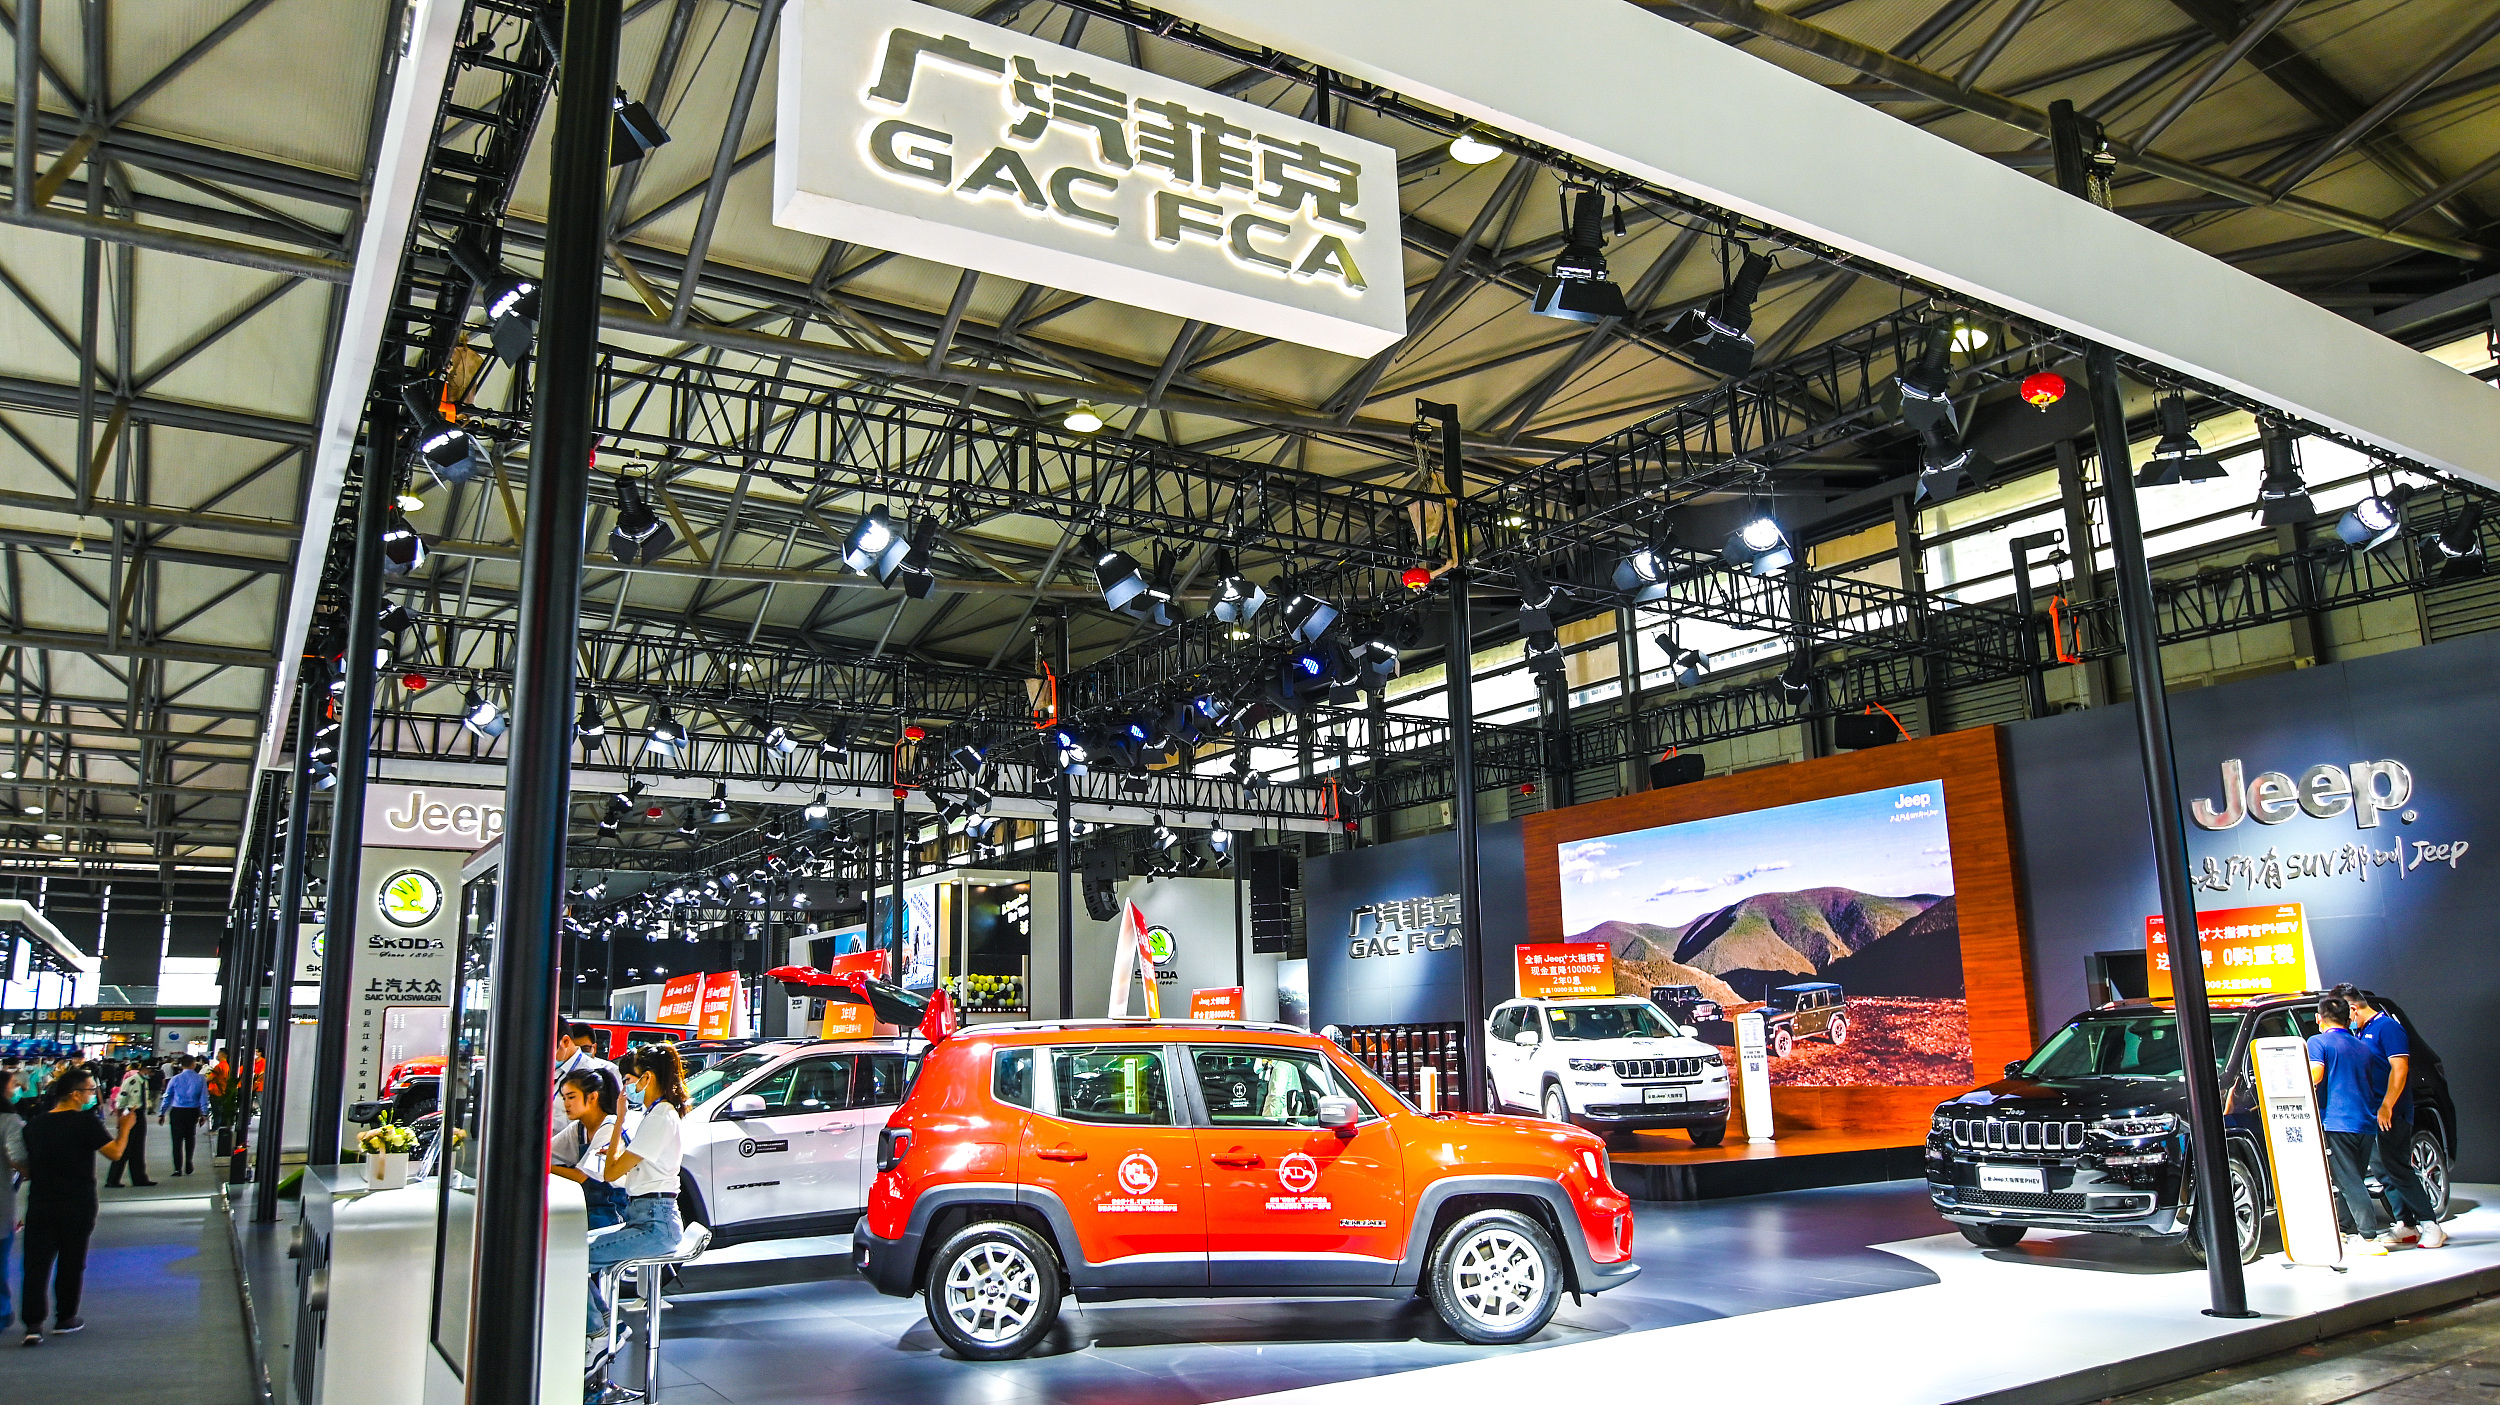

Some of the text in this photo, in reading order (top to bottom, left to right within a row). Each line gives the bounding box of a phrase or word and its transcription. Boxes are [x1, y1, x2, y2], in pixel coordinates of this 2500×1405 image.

[866, 28, 1367, 234] 广汽菲克
[868, 119, 1368, 292] GAC FCA
[1894, 793, 1931, 809] Jeep
[2191, 759, 2413, 829] Jeep
[388, 792, 505, 841] Jeep
[1348, 893, 1462, 937] 广汽菲克
[368, 934, 445, 949] ŠKODA
[1349, 927, 1462, 959] GAC FCA
[365, 978, 443, 993] 上汽大众
